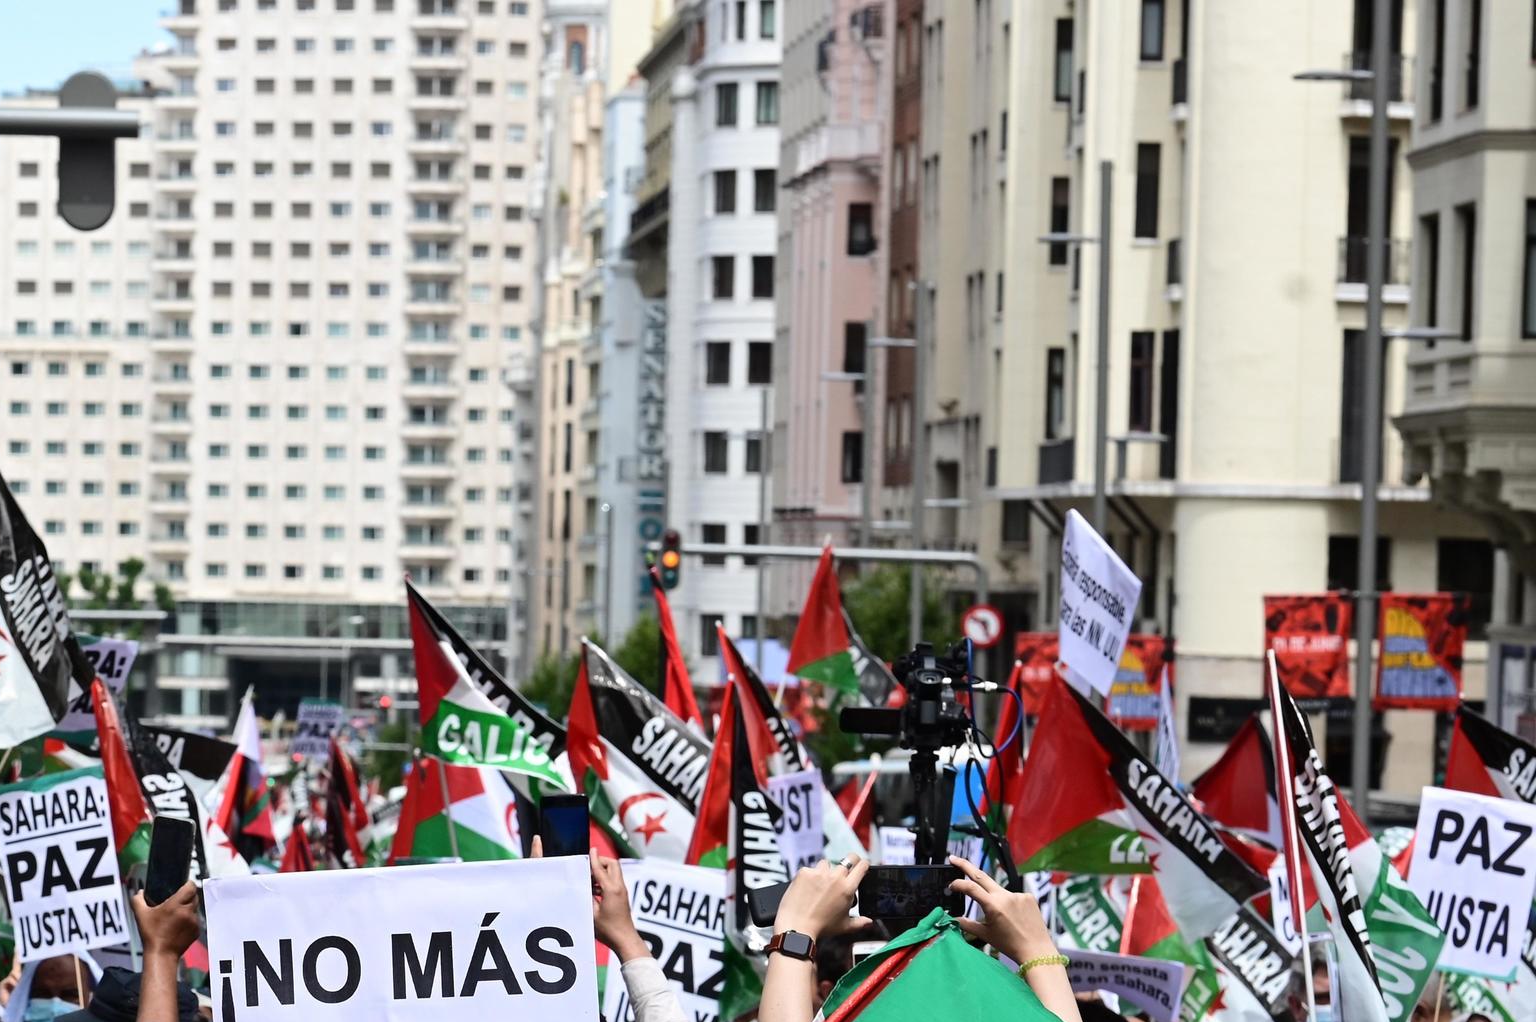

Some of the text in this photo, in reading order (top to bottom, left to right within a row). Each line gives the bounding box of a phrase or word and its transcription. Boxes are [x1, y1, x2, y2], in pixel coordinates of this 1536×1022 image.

[639, 302, 666, 481] SENATOR
[7, 839, 115, 903] PAZ
[1429, 810, 1534, 877] PAZ
[391, 912, 578, 1000] MÁS
[1100, 961, 1169, 983] sensata
[1087, 975, 1109, 985] en
[1114, 973, 1173, 1011] Sahara.
